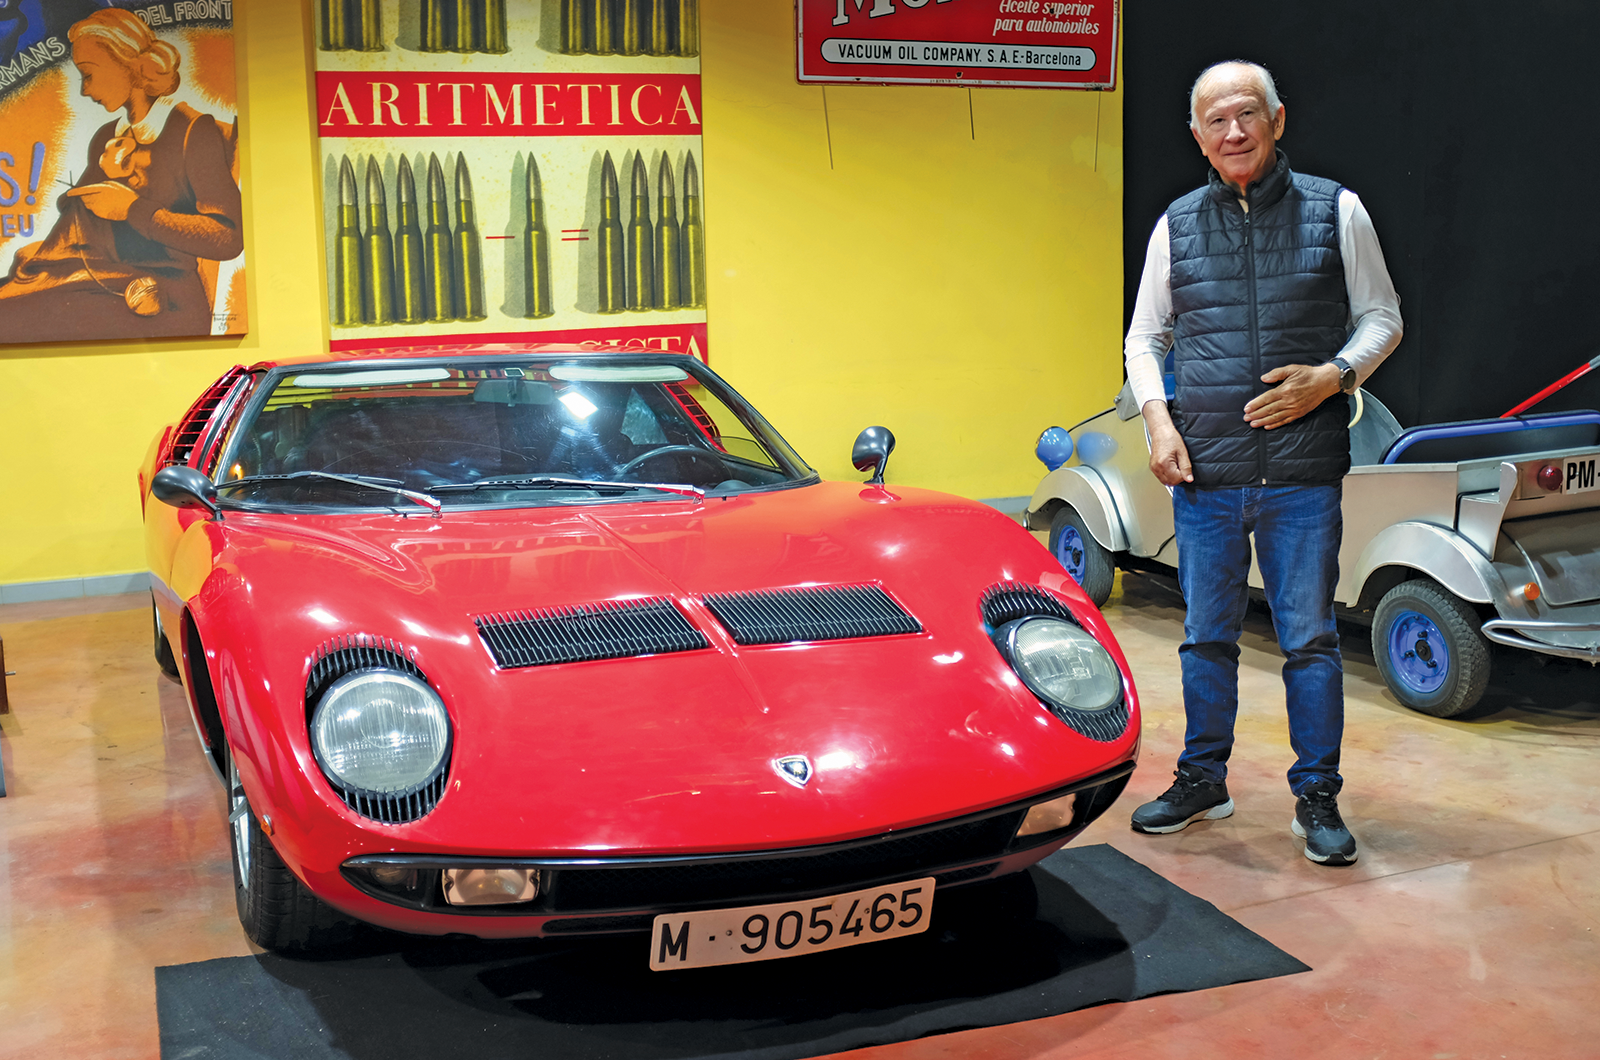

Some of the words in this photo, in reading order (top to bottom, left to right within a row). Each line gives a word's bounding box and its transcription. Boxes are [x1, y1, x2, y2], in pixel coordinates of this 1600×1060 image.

[134, 2, 173, 26] DEL
[173, 0, 232, 21] FRONT
[1000, 0, 1040, 14] Aceite
[1042, 1, 1095, 19] superior
[992, 18, 1024, 36] para
[838, 43, 892, 60] VACUUM
[898, 45, 918, 60] OIL
[320, 81, 700, 126] ARITMETICA
[1565, 459, 1600, 491] PM
